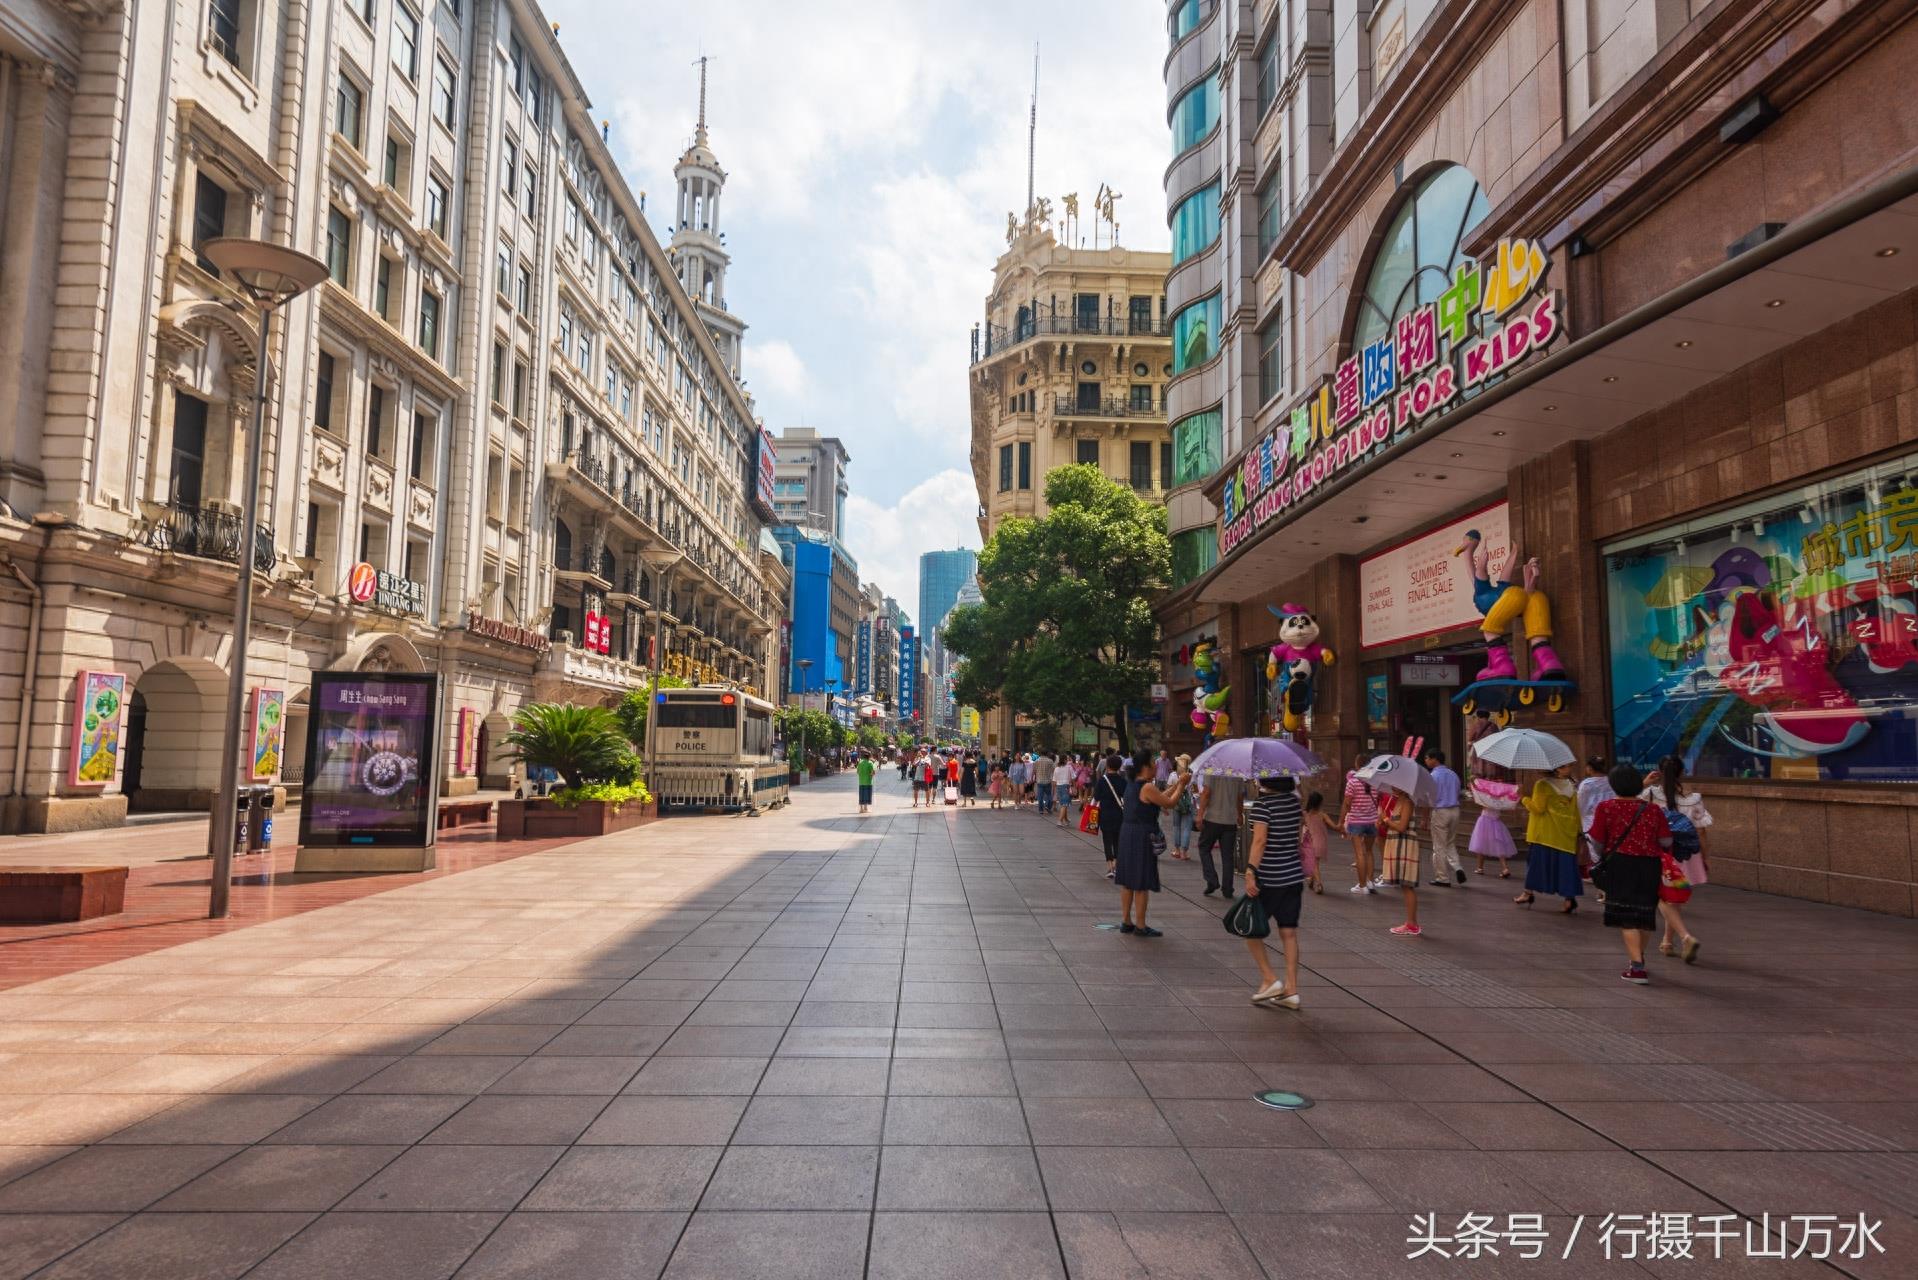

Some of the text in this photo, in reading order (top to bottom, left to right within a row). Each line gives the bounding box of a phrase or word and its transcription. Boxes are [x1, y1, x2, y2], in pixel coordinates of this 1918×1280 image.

[1223, 236, 1547, 528] 宝大祥青少年儿童购物中心
[1253, 477, 1292, 528] XIANG
[1292, 402, 1390, 502] SHOPPING
[1395, 363, 1458, 433] FOR
[1464, 290, 1557, 389] KIDS
[1410, 561, 1449, 585] SUMMER
[379, 570, 420, 600] 锦江之星
[1369, 587, 1391, 601] SUMMER
[1407, 582, 1433, 605] FINAL
[1432, 578, 1454, 597] SALE
[1367, 597, 1394, 613] FINAL SALE
[339, 689, 362, 704] 周生生
[379, 694, 393, 706] Sang
[393, 694, 407, 706] Sang
[683, 730, 700, 739] 警察
[675, 743, 706, 751] POLICE
